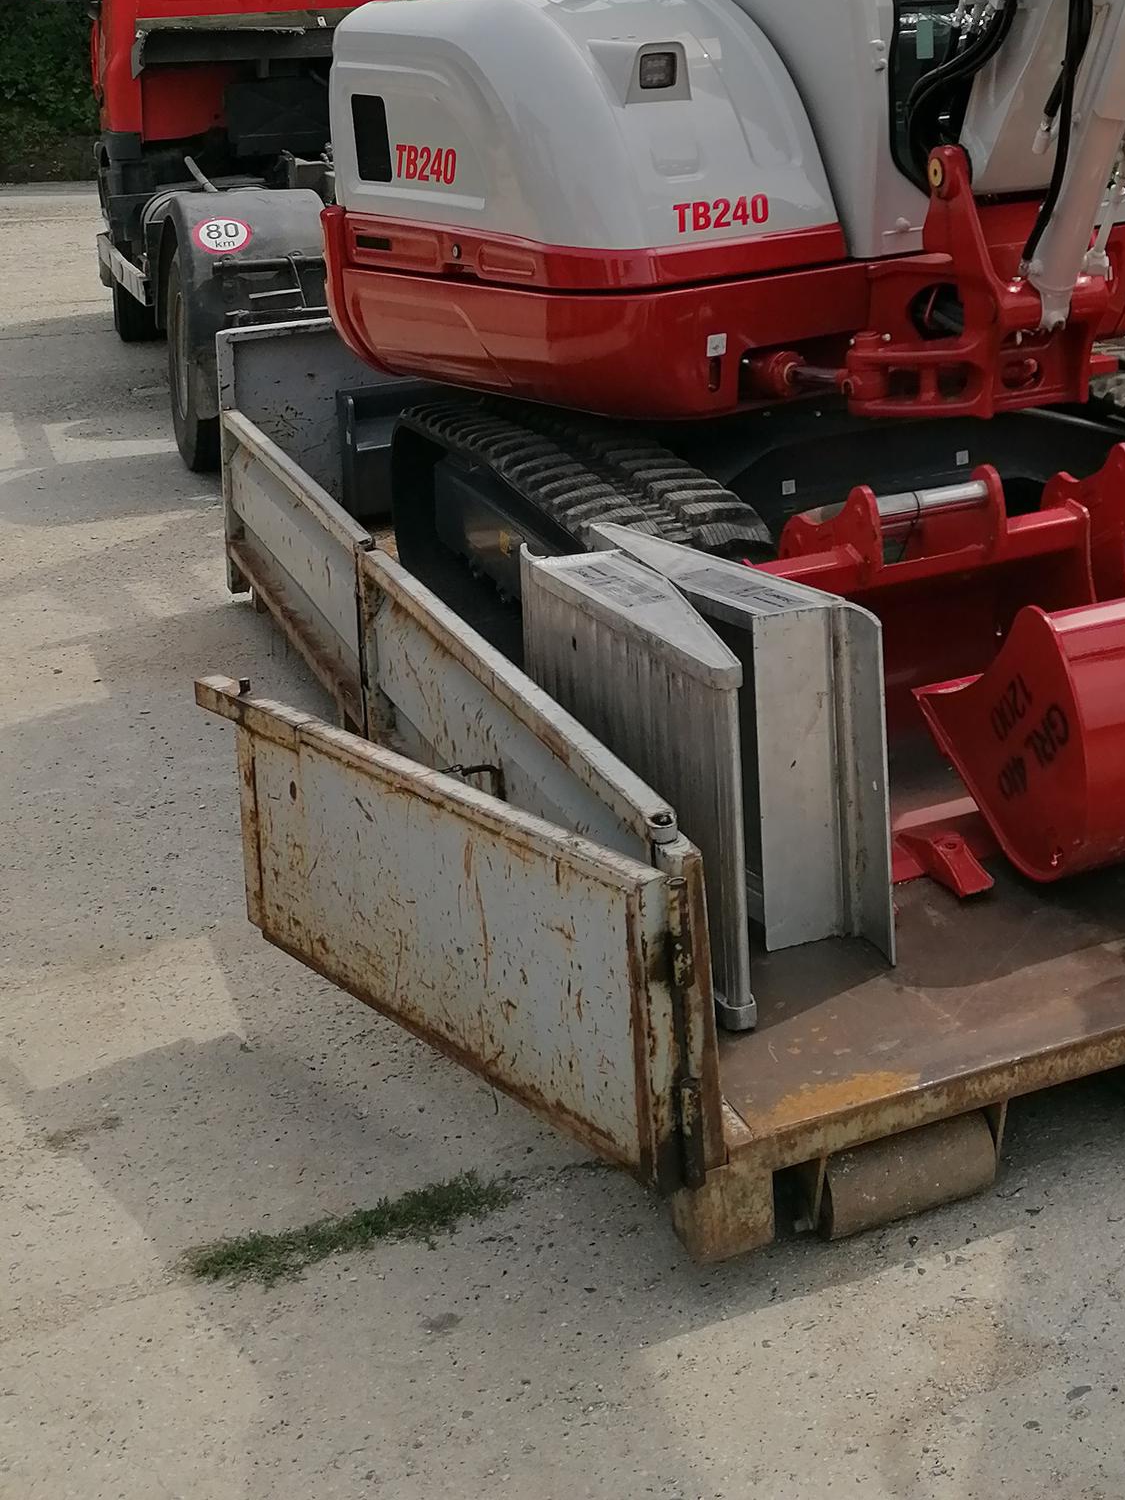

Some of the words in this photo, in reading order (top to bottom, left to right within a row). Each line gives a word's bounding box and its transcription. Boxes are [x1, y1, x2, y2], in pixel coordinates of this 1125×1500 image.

[395, 144, 457, 185] TB240
[206, 222, 239, 239] 80
[672, 193, 769, 233] TB240
[214, 240, 235, 248] km
[990, 673, 1032, 741] 1200
